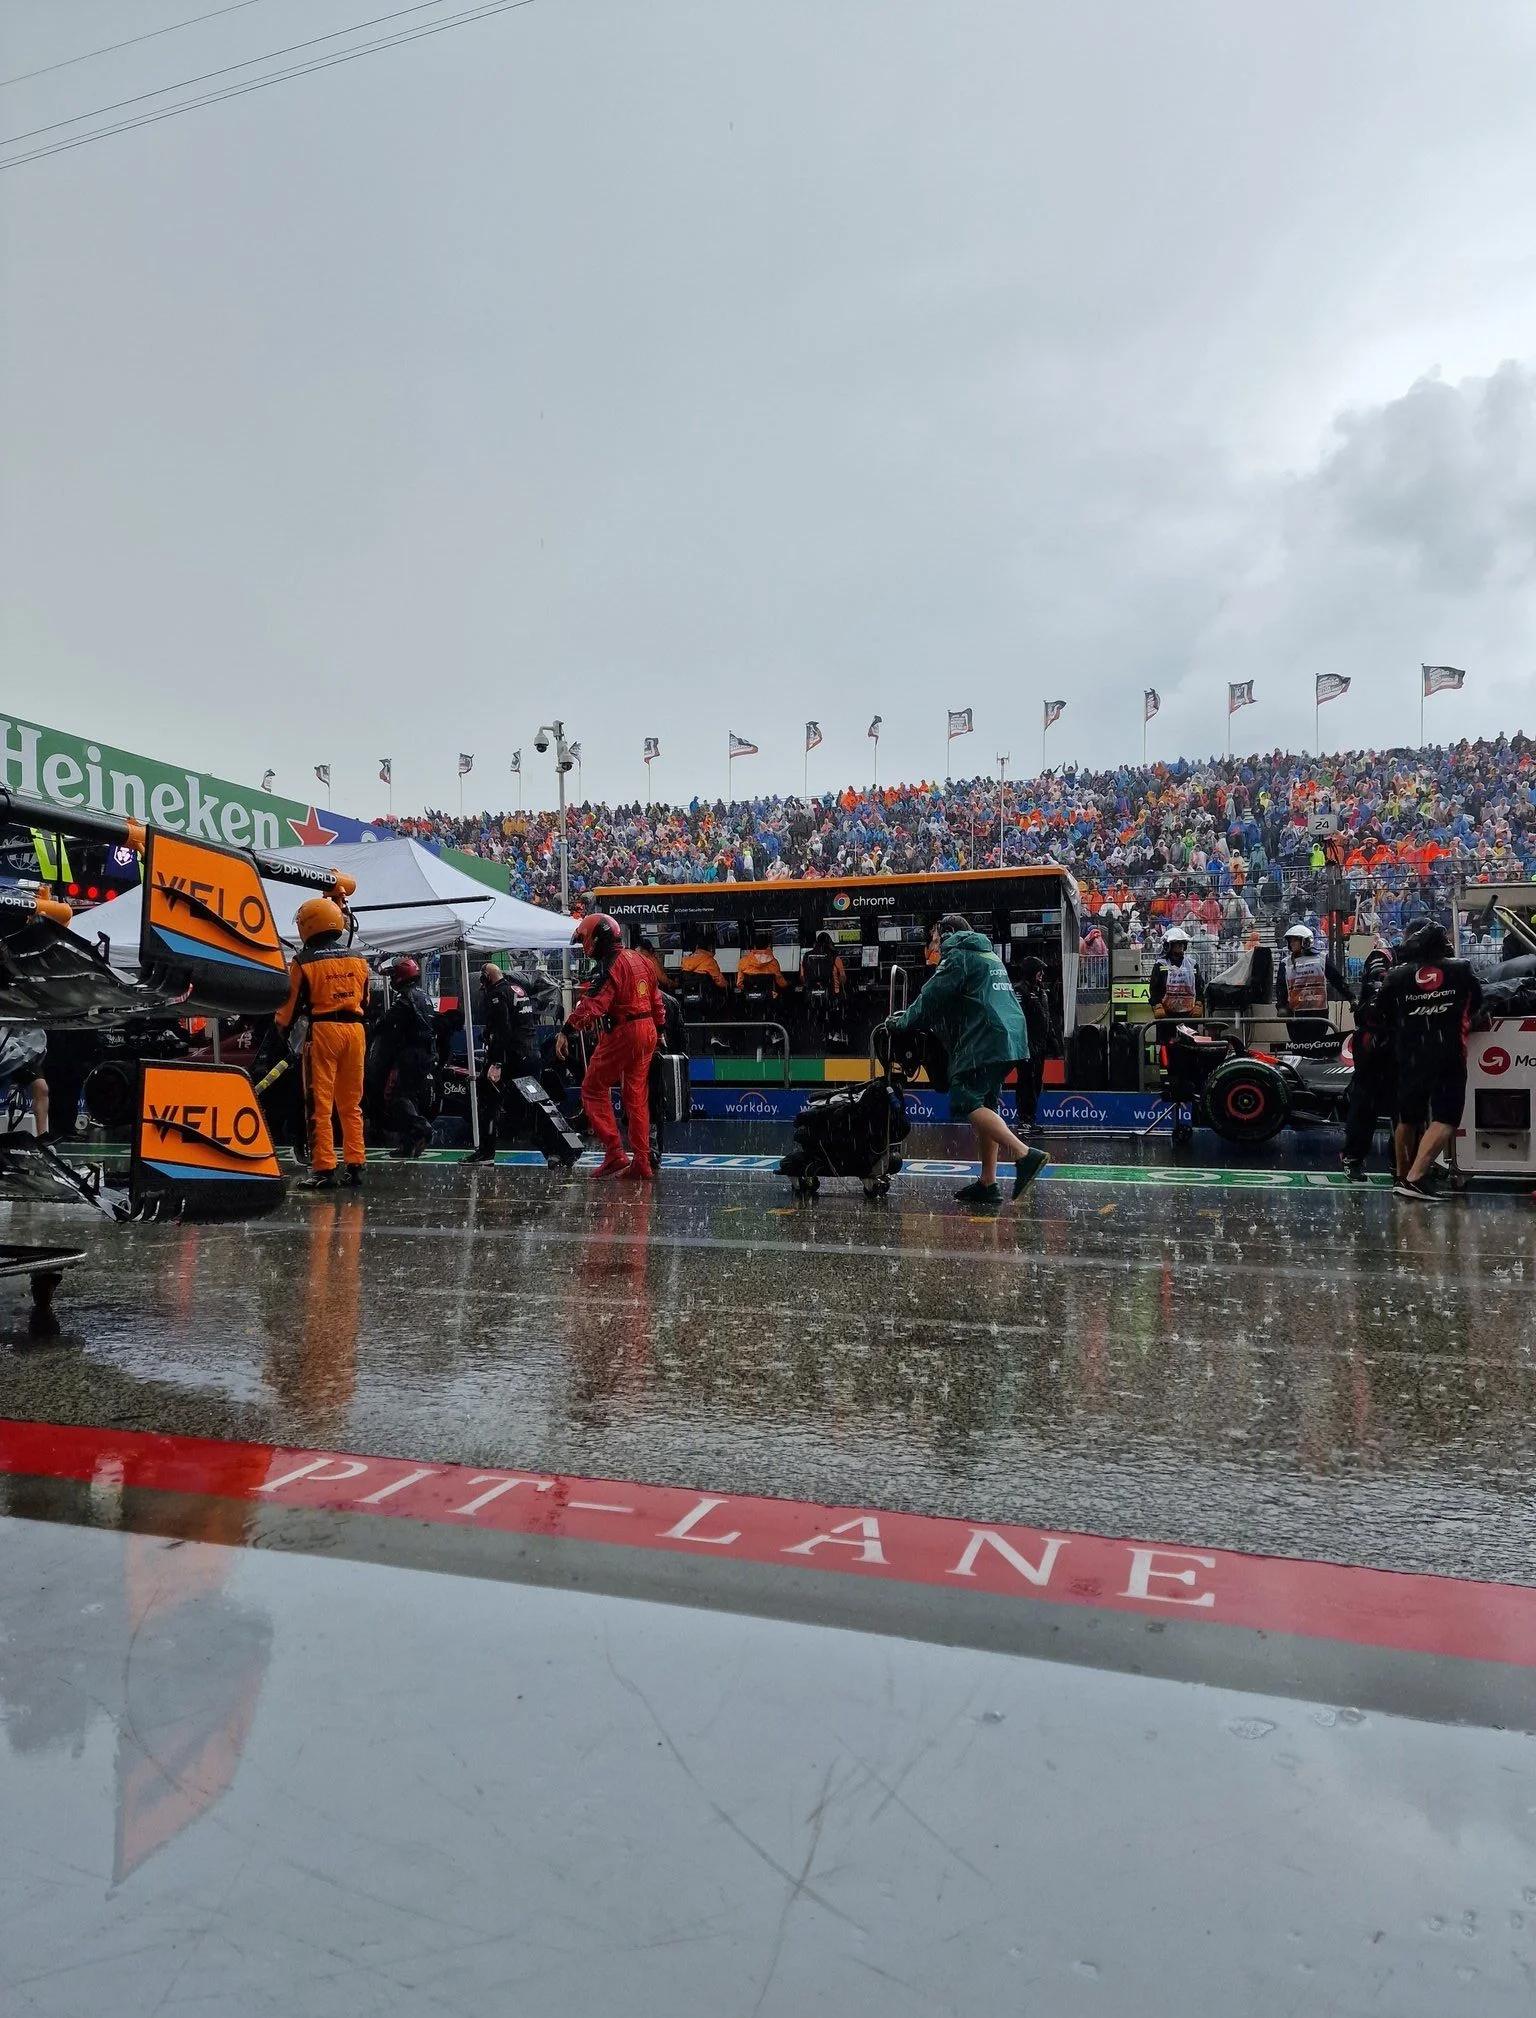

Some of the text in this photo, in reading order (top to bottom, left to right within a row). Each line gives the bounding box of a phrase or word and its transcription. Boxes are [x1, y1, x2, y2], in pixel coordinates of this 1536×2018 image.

[0, 719, 280, 849] Heineken
[1315, 821, 1330, 830] 24
[284, 864, 337, 884] DP WORLD
[852, 896, 896, 907] chrome
[609, 904, 670, 915] DARKTRACE
[1405, 989, 1456, 1002] MoneyGram
[1285, 1040, 1340, 1051] MoneyGram
[443, 1081, 467, 1096] Stake
[149, 1104, 261, 1146] VELO
